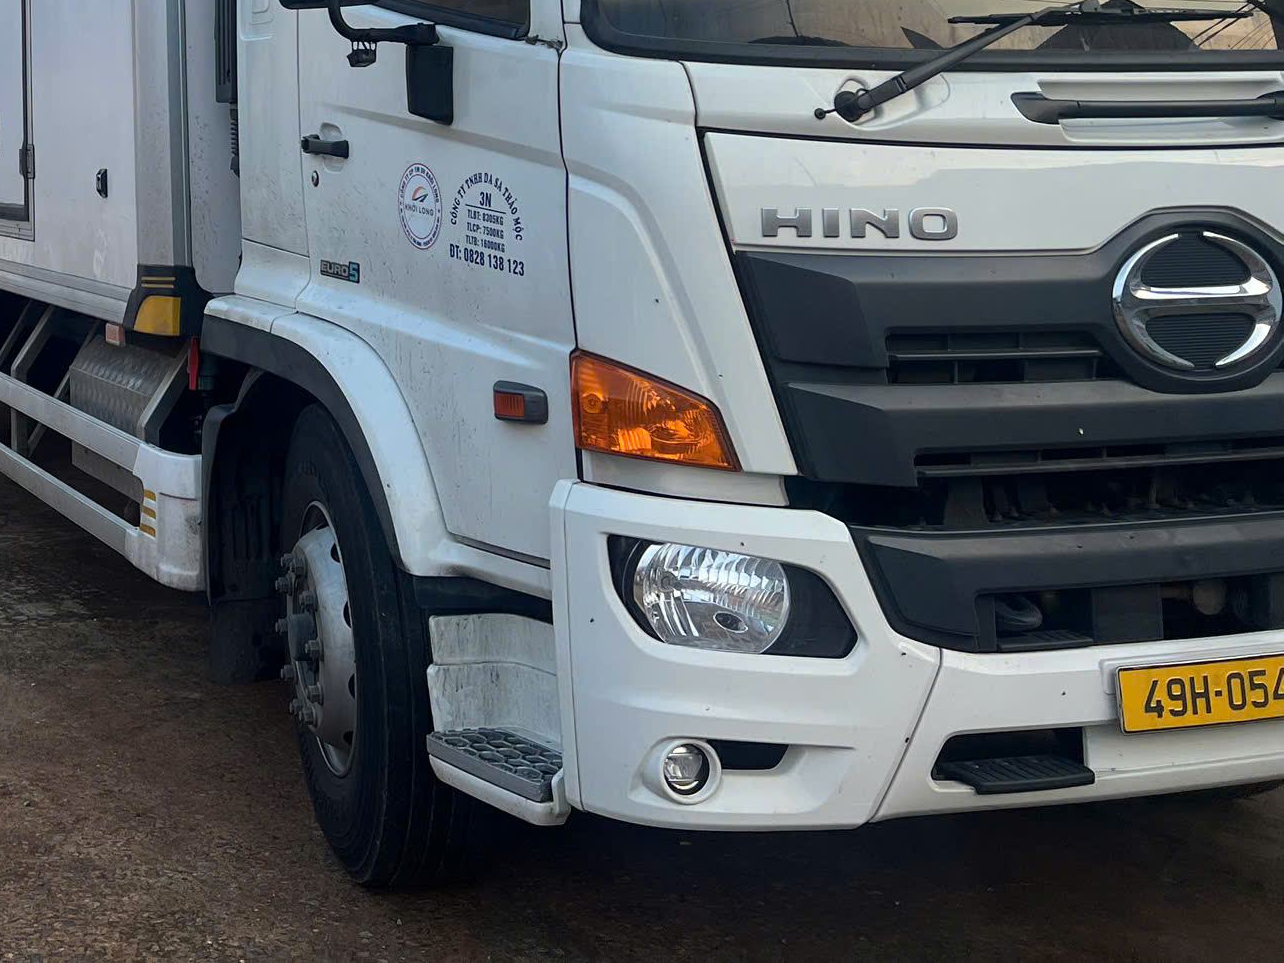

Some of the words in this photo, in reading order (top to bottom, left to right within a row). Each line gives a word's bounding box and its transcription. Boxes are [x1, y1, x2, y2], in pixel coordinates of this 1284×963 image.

[419, 207, 435, 217] LONG
[449, 197, 461, 225] CÔNG
[458, 184, 466, 199] TY
[465, 172, 483, 189] TNHH
[484, 172, 493, 185] DA
[494, 177, 503, 192] SA
[512, 217, 524, 241] MỘC
[479, 191, 492, 208] 3N
[761, 207, 958, 241] HINO
[463, 247, 485, 266] 0828
[487, 253, 504, 271] 138
[507, 258, 525, 277] 123
